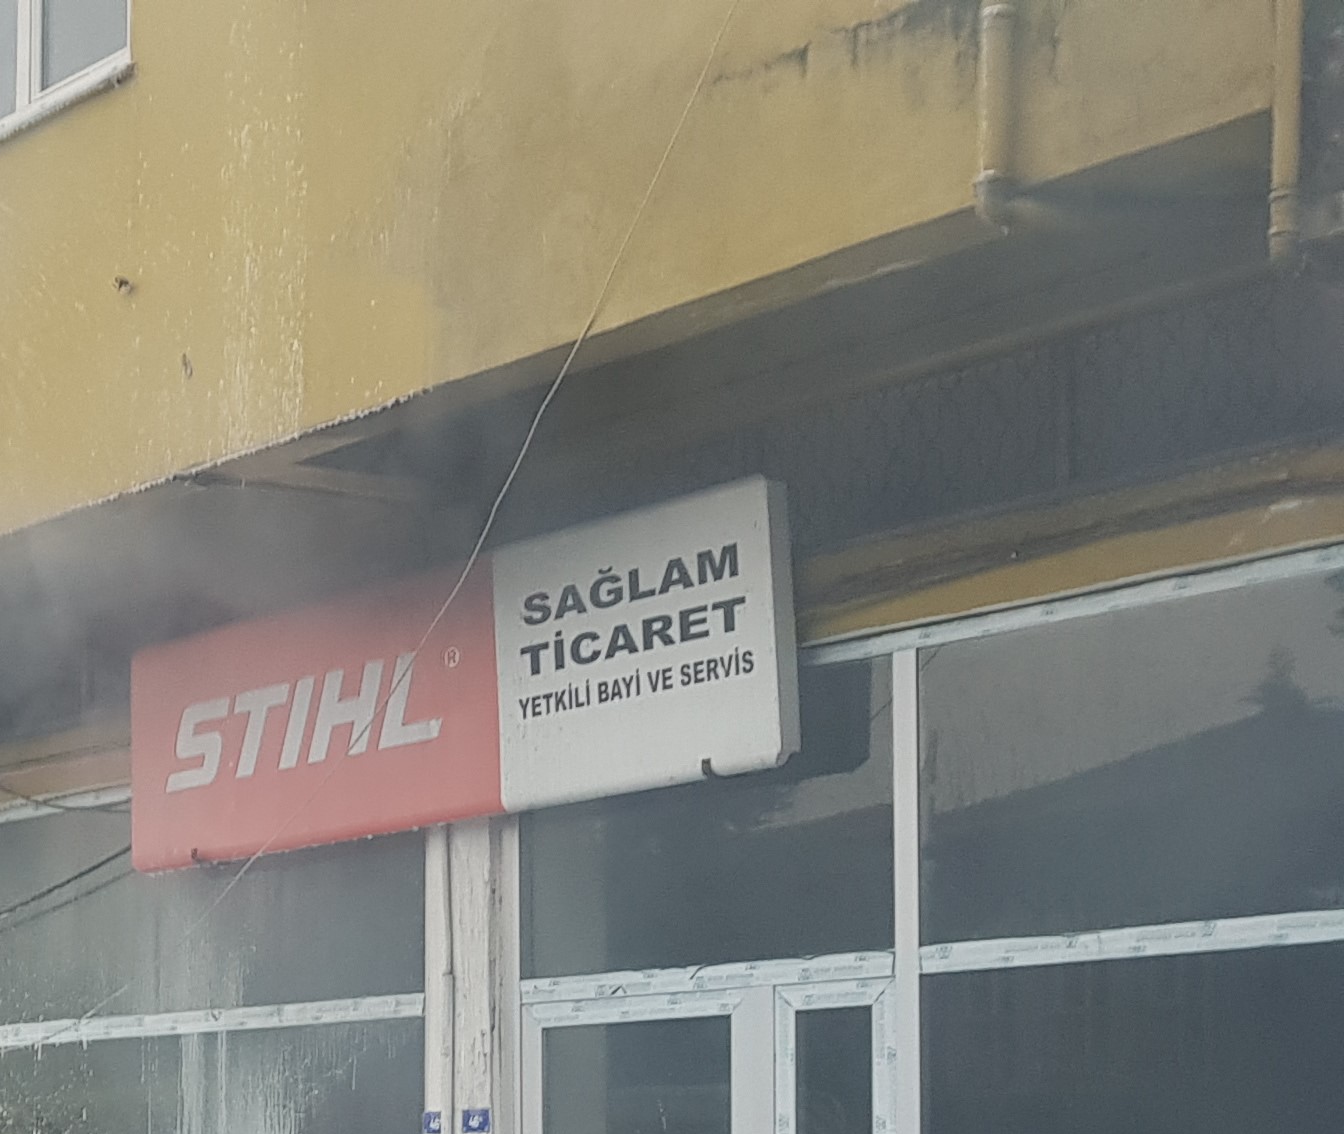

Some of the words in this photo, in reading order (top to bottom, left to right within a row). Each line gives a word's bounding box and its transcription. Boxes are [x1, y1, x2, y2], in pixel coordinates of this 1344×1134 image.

[522, 542, 739, 627] SAĞLAM
[520, 596, 747, 677] TİCARET
[165, 651, 443, 794] STIHL
[518, 678, 592, 720] YETKİLİ
[597, 668, 642, 705] BAYİ
[647, 666, 674, 694] VE
[680, 646, 755, 687] SERVİS
